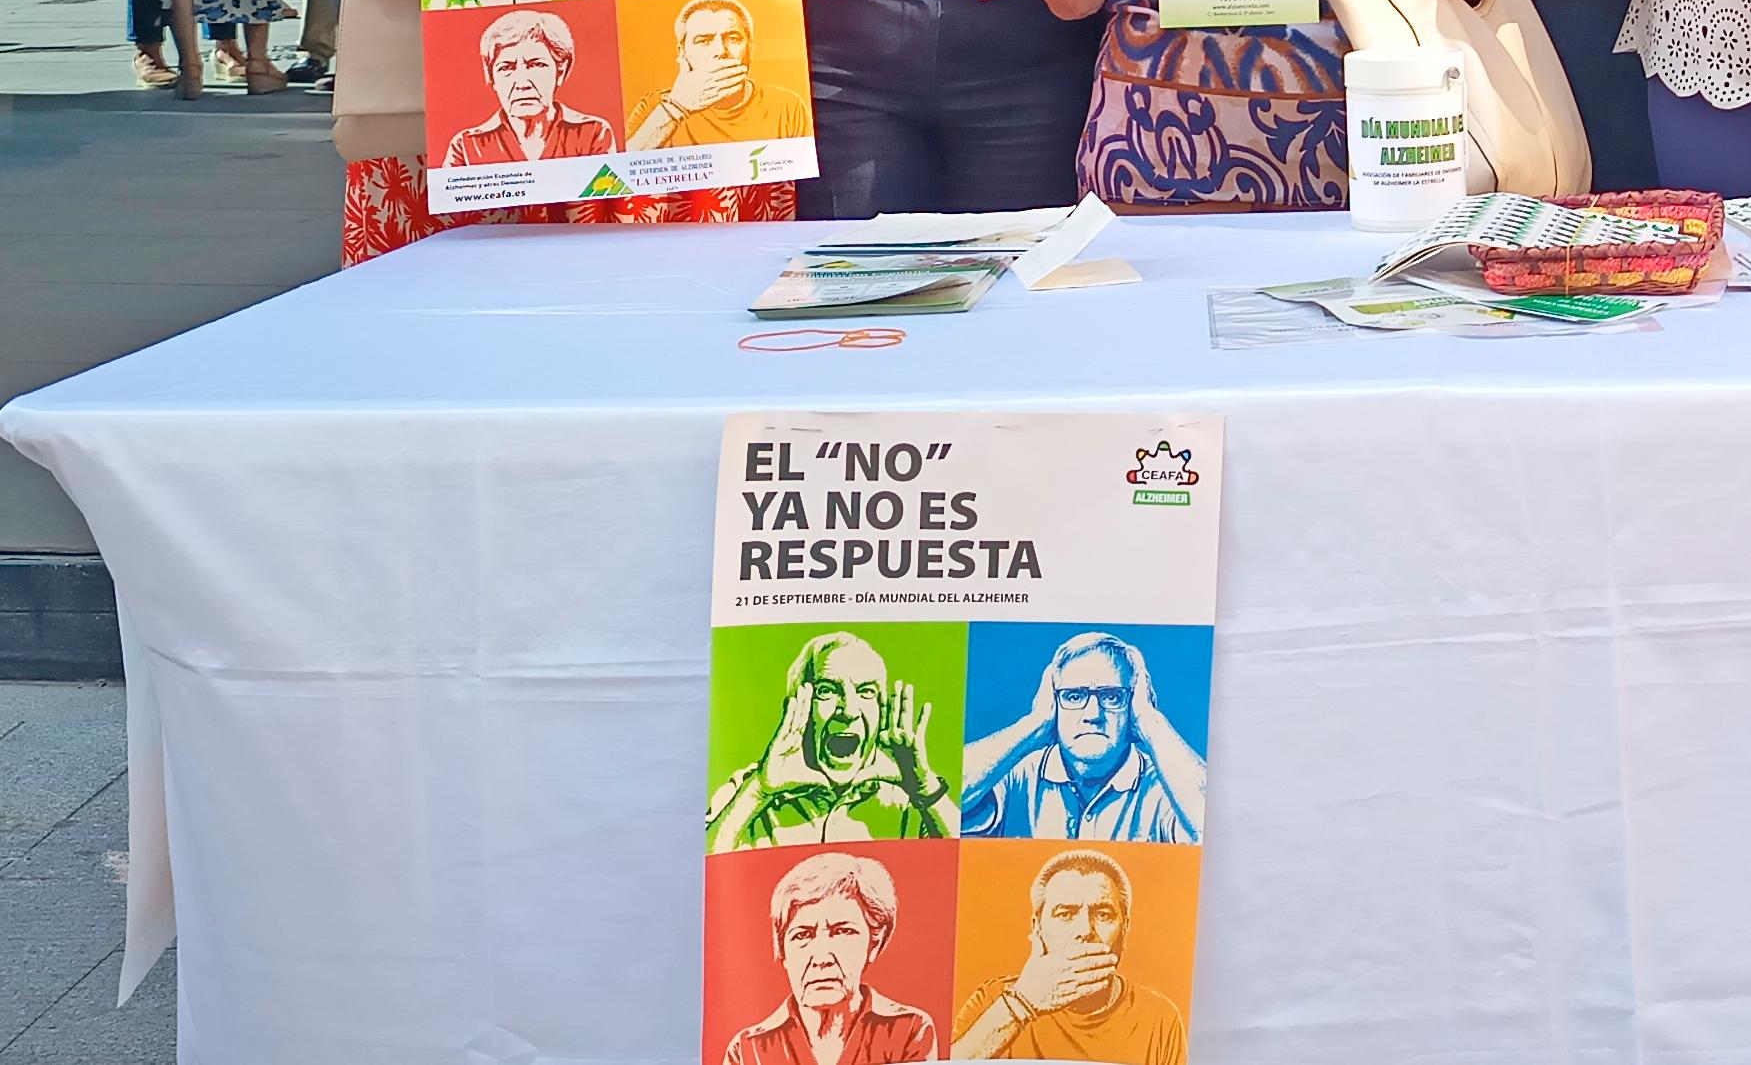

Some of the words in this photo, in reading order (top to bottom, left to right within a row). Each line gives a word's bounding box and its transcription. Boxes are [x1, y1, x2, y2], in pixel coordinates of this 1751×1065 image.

[1361, 117, 1383, 139] DÍA
[1386, 117, 1449, 139] MUNDIAL
[1381, 143, 1455, 165] ALZHEIMER
[455, 190, 526, 202] www.ceafa.es
[745, 442, 804, 483] EL
[1142, 470, 1185, 482] CEAFA
[1134, 492, 1189, 505] ALZHEIMER
[741, 491, 809, 532] YA
[825, 491, 904, 532] NO
[919, 492, 977, 531] ES
[739, 539, 1042, 582] RESPUESTA
[736, 596, 750, 607] 21
[753, 595, 769, 606] DE
[772, 594, 846, 606] SEPTIEMBRE
[856, 591, 876, 605] DÍA
[879, 592, 935, 605] MUNDIAL
[938, 593, 960, 604] DEL
[962, 592, 1029, 604] ALZHEIMER
